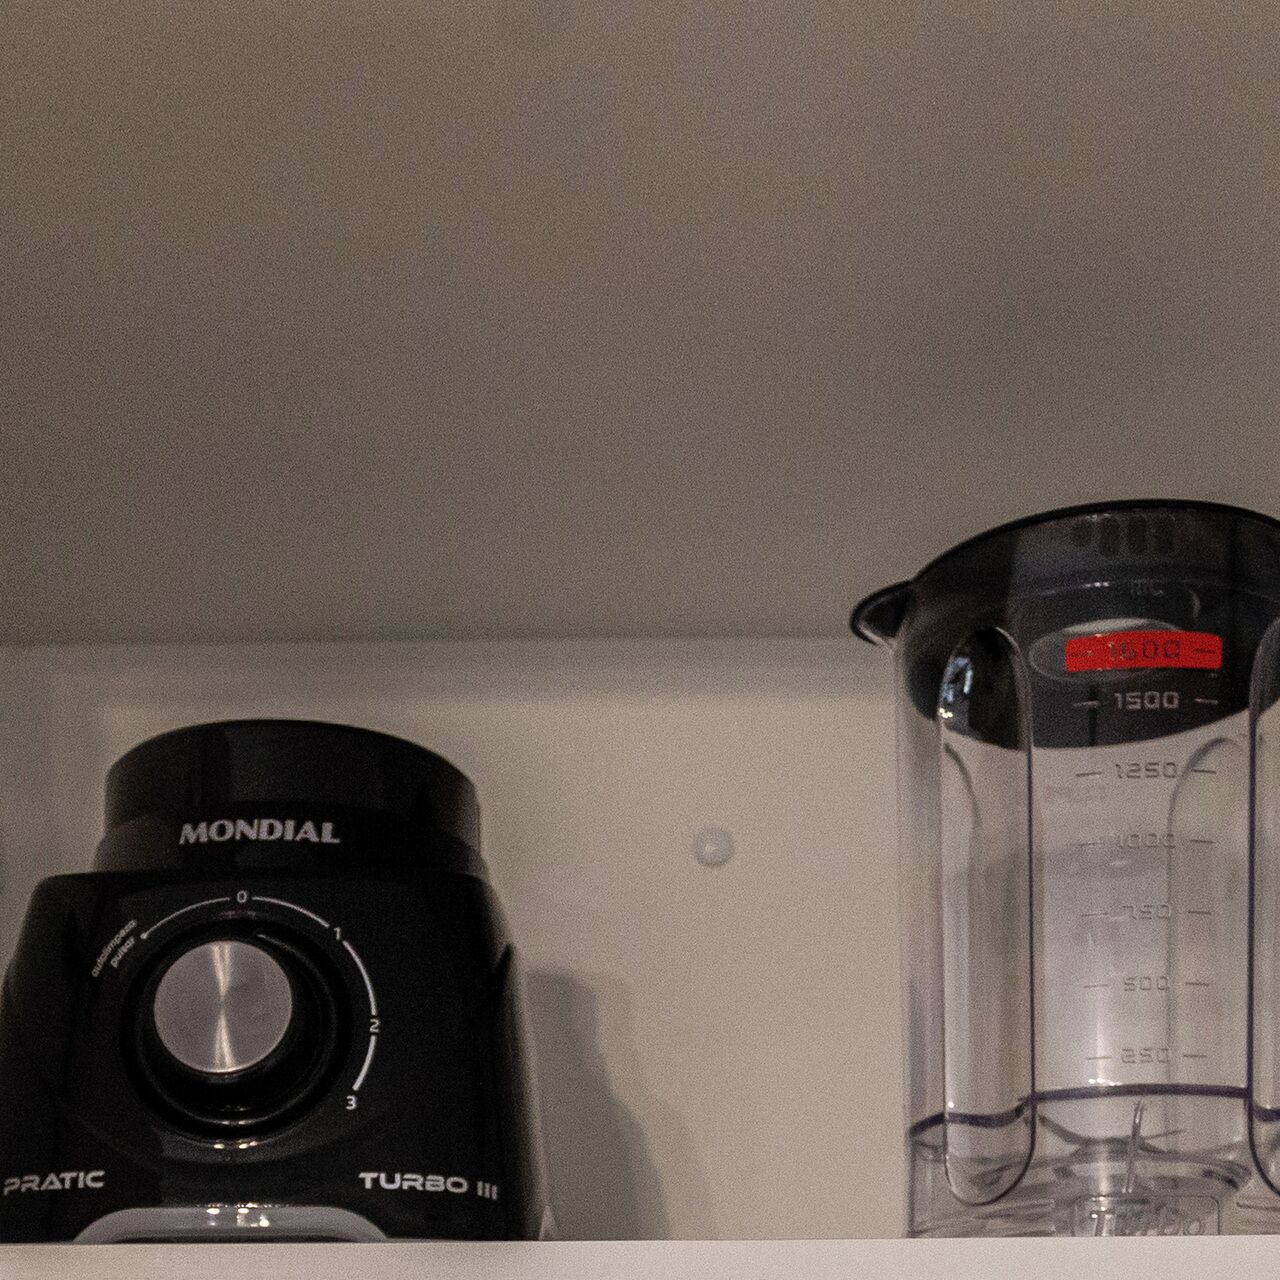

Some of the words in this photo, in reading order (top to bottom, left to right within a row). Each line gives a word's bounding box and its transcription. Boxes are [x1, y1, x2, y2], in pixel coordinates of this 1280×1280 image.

[1114, 690, 1180, 710] 1500
[1115, 761, 1178, 779] 1250
[179, 818, 342, 845] MONDIAL
[236, 889, 248, 904] 0
[1122, 904, 1169, 921] 750
[333, 926, 342, 941] 1
[110, 935, 135, 969] pulsar
[1123, 975, 1169, 992] 500
[369, 1017, 381, 1033] 2
[1122, 1047, 1169, 1065] 250
[345, 1094, 358, 1111] 3
[3, 1170, 106, 1196] PRATIC
[358, 1171, 469, 1194] TURBO
[476, 1180, 498, 1201] III
